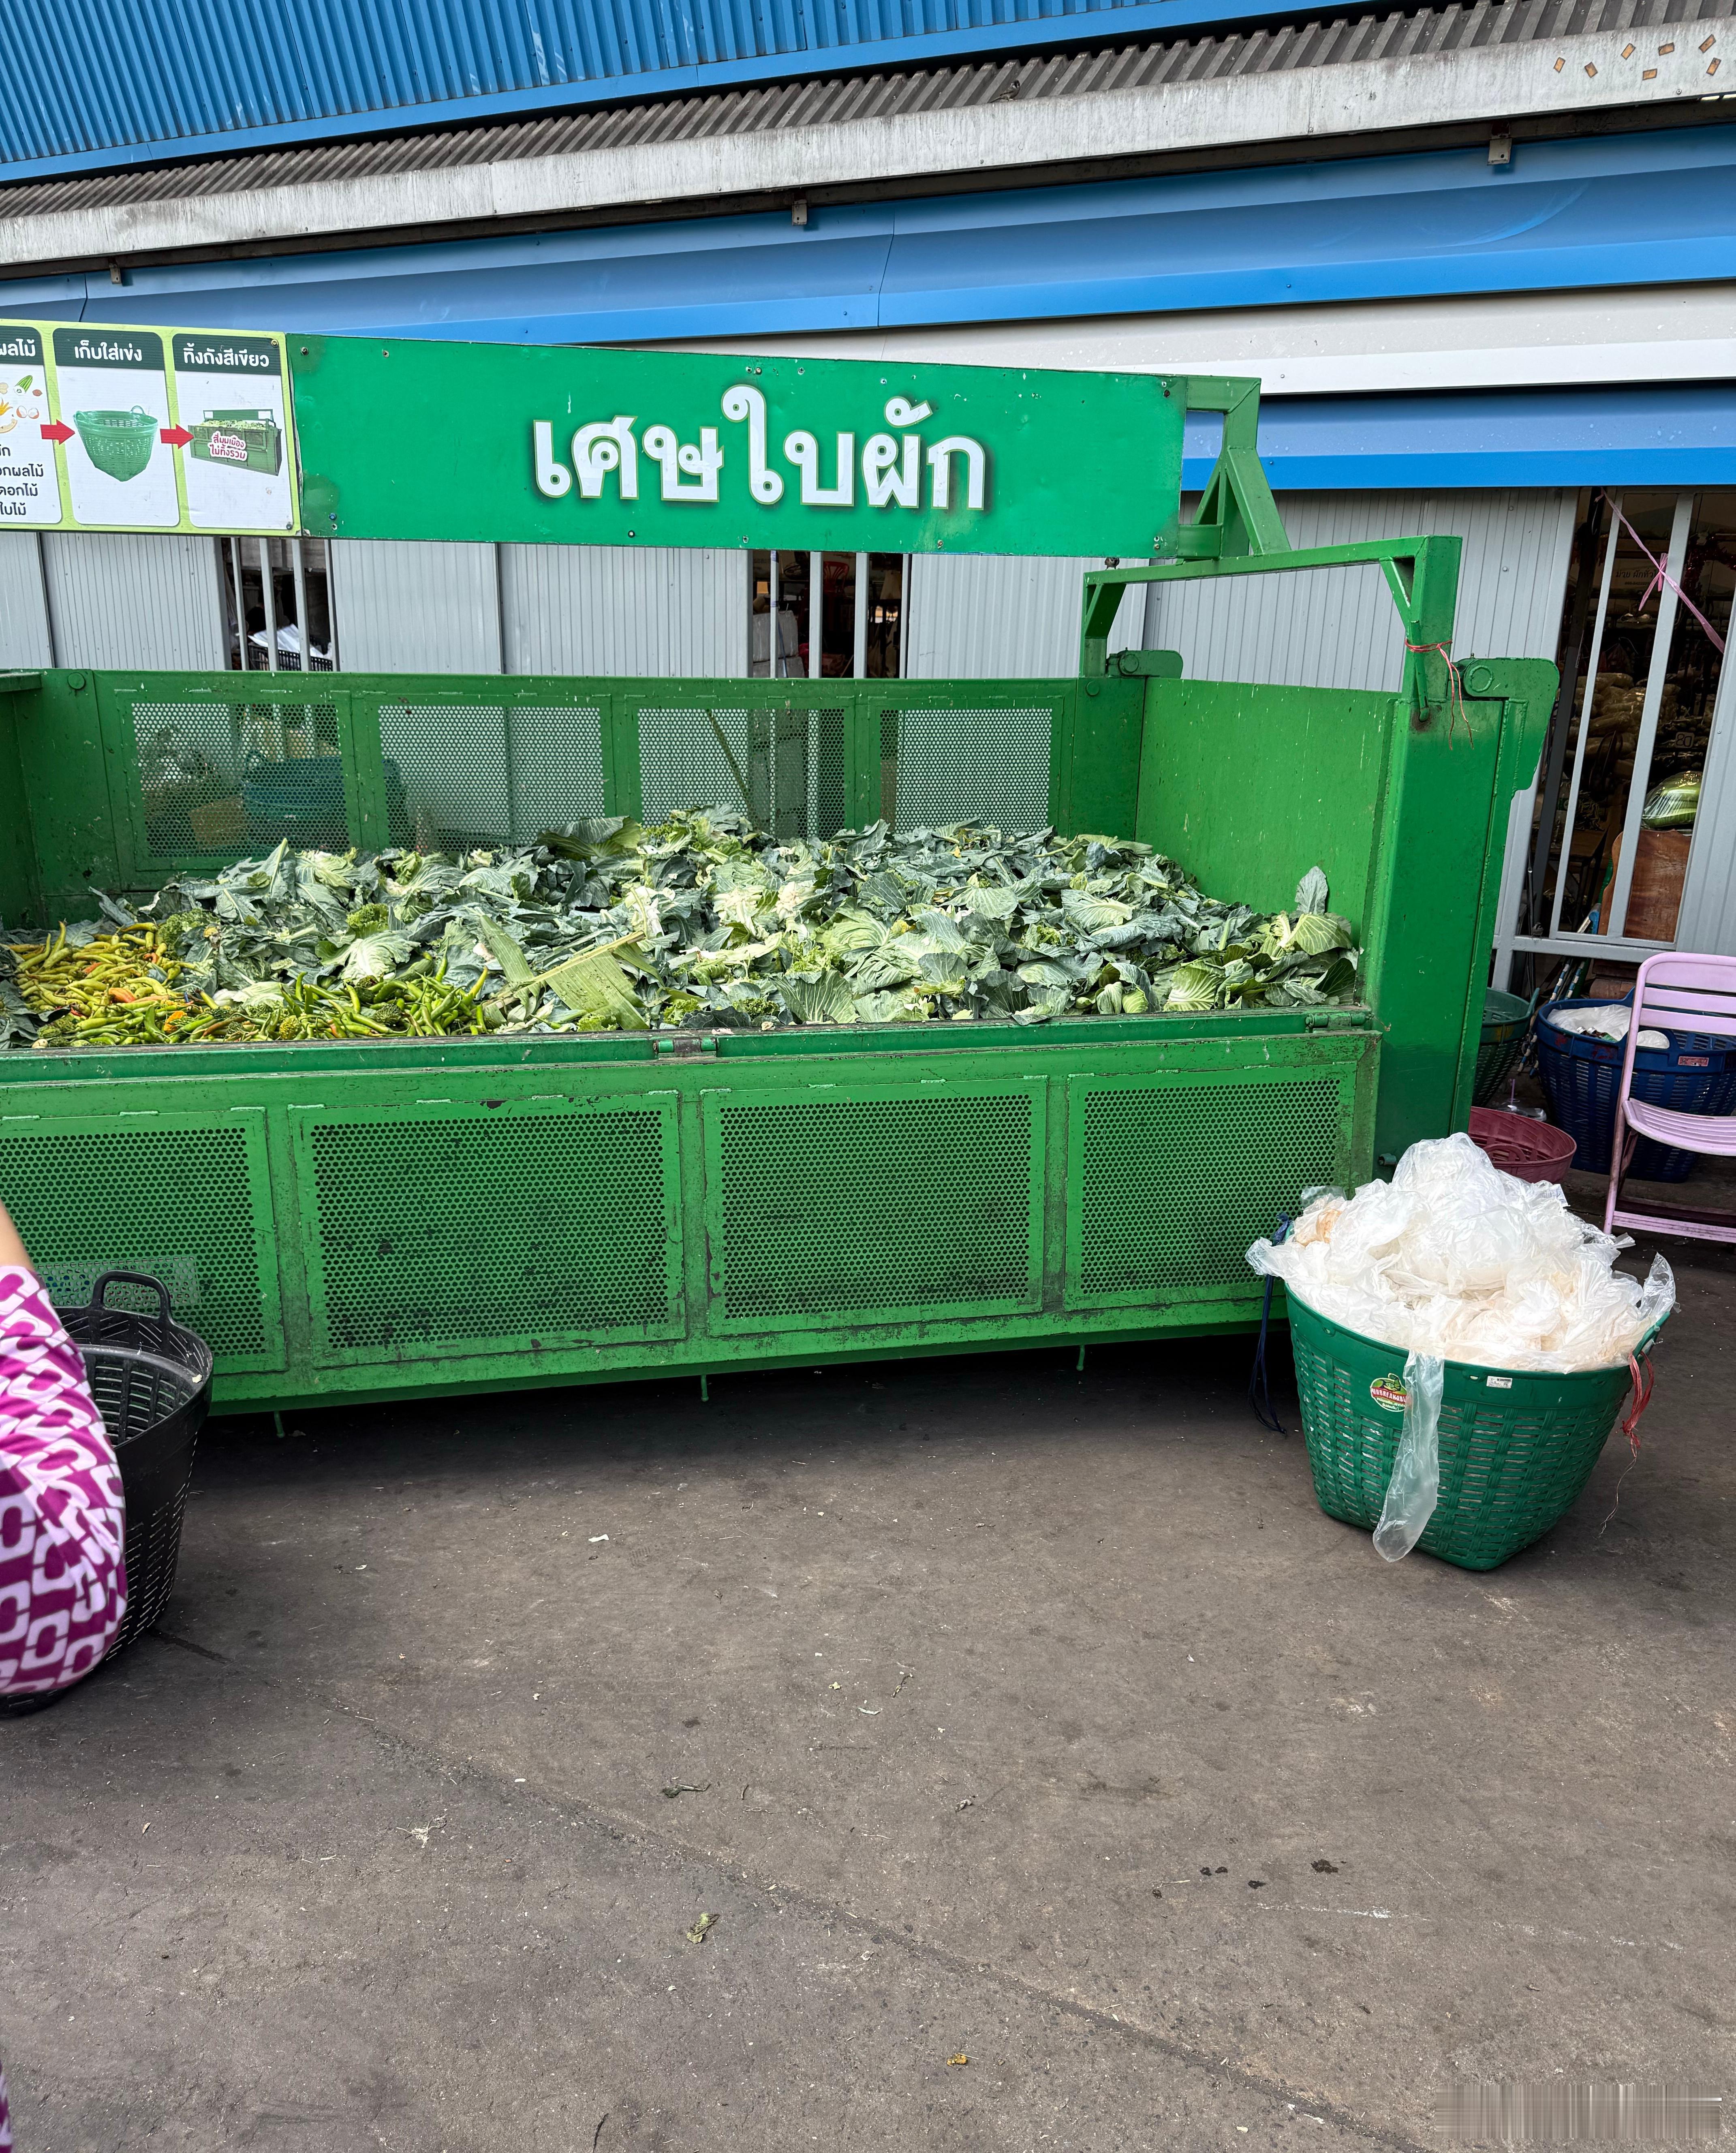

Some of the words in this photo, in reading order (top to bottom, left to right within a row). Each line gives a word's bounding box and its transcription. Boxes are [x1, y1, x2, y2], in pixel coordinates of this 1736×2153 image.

[74, 340, 142, 362] เก็บใส่เข่ง
[183, 342, 269, 367] ทิ้งถังสีเขียว
[210, 444, 246, 459] ไม่ทิ้งรวม
[533, 384, 985, 511] เศษใบผัก
[0, 464, 44, 477] กผลไม้
[1371, 1387, 1407, 1402] UNBREAKABL
